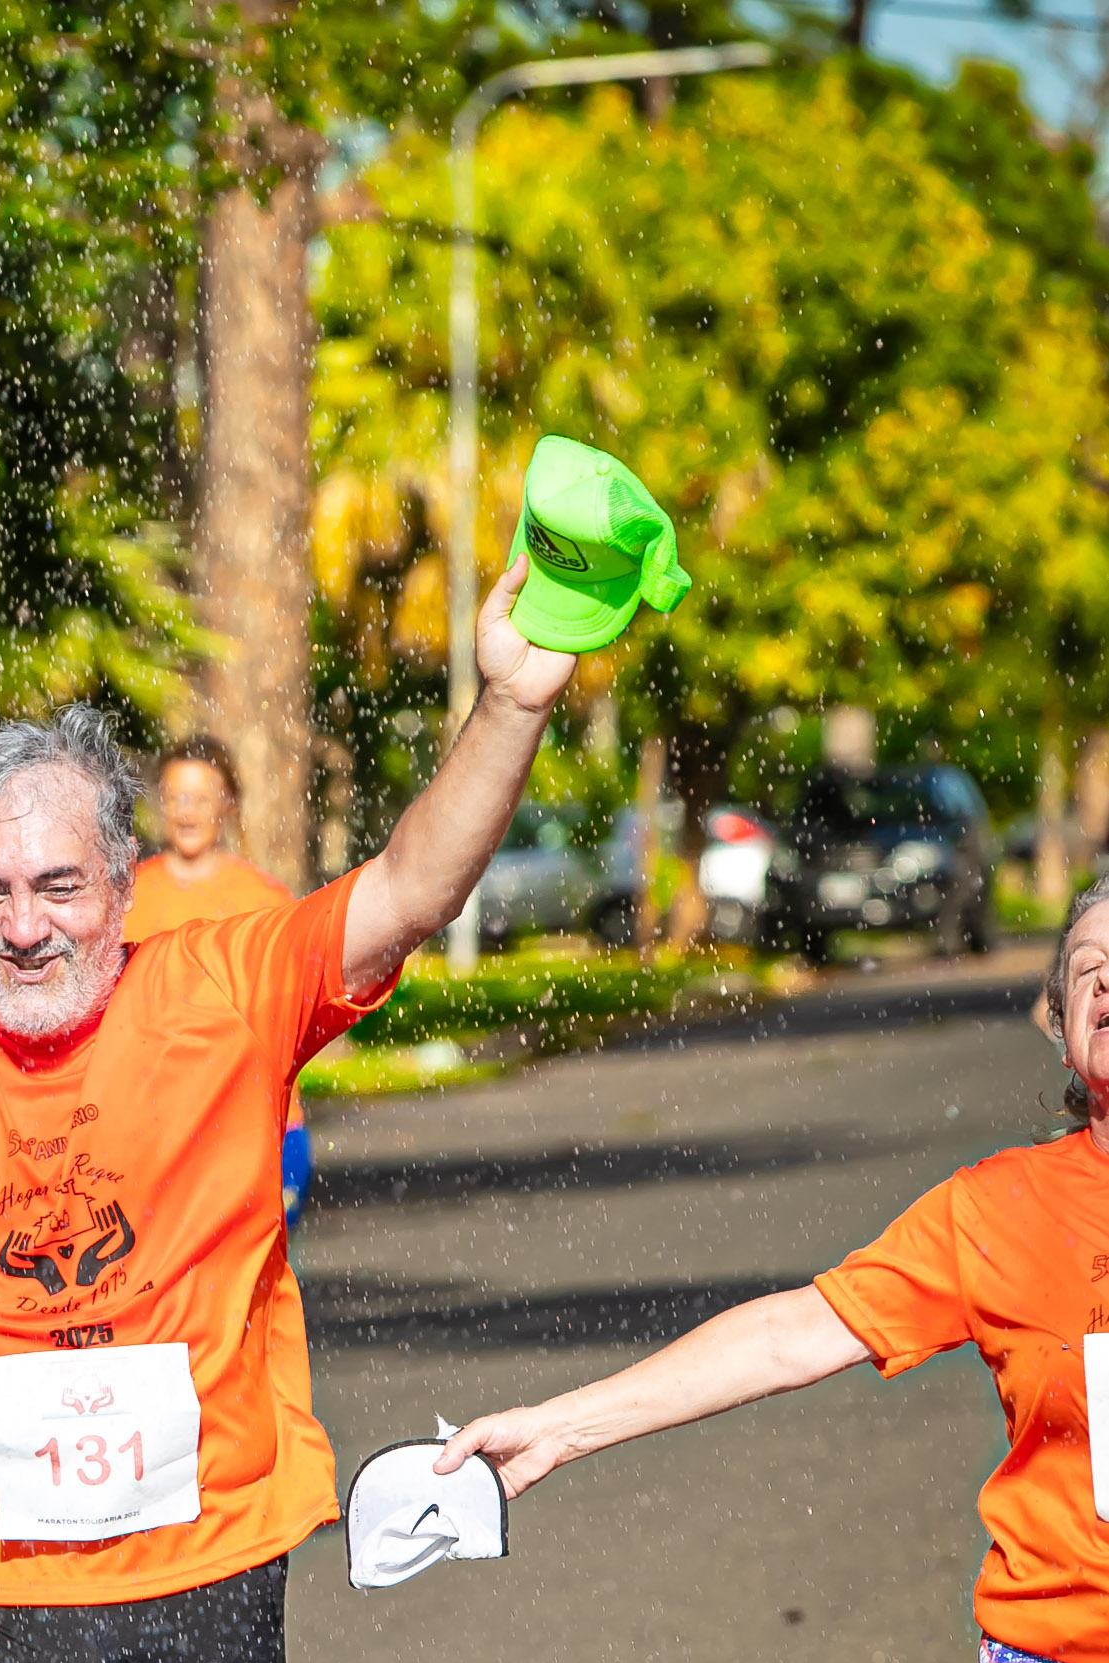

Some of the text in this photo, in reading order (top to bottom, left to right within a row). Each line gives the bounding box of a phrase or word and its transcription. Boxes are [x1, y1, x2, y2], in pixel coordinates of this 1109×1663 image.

[16, 1296, 81, 1315] Desde
[91, 1266, 127, 1305] 1975
[49, 1322, 114, 1349] 2025
[35, 1431, 144, 1486] 131
[80, 1514, 122, 1525] SOLIDARIA
